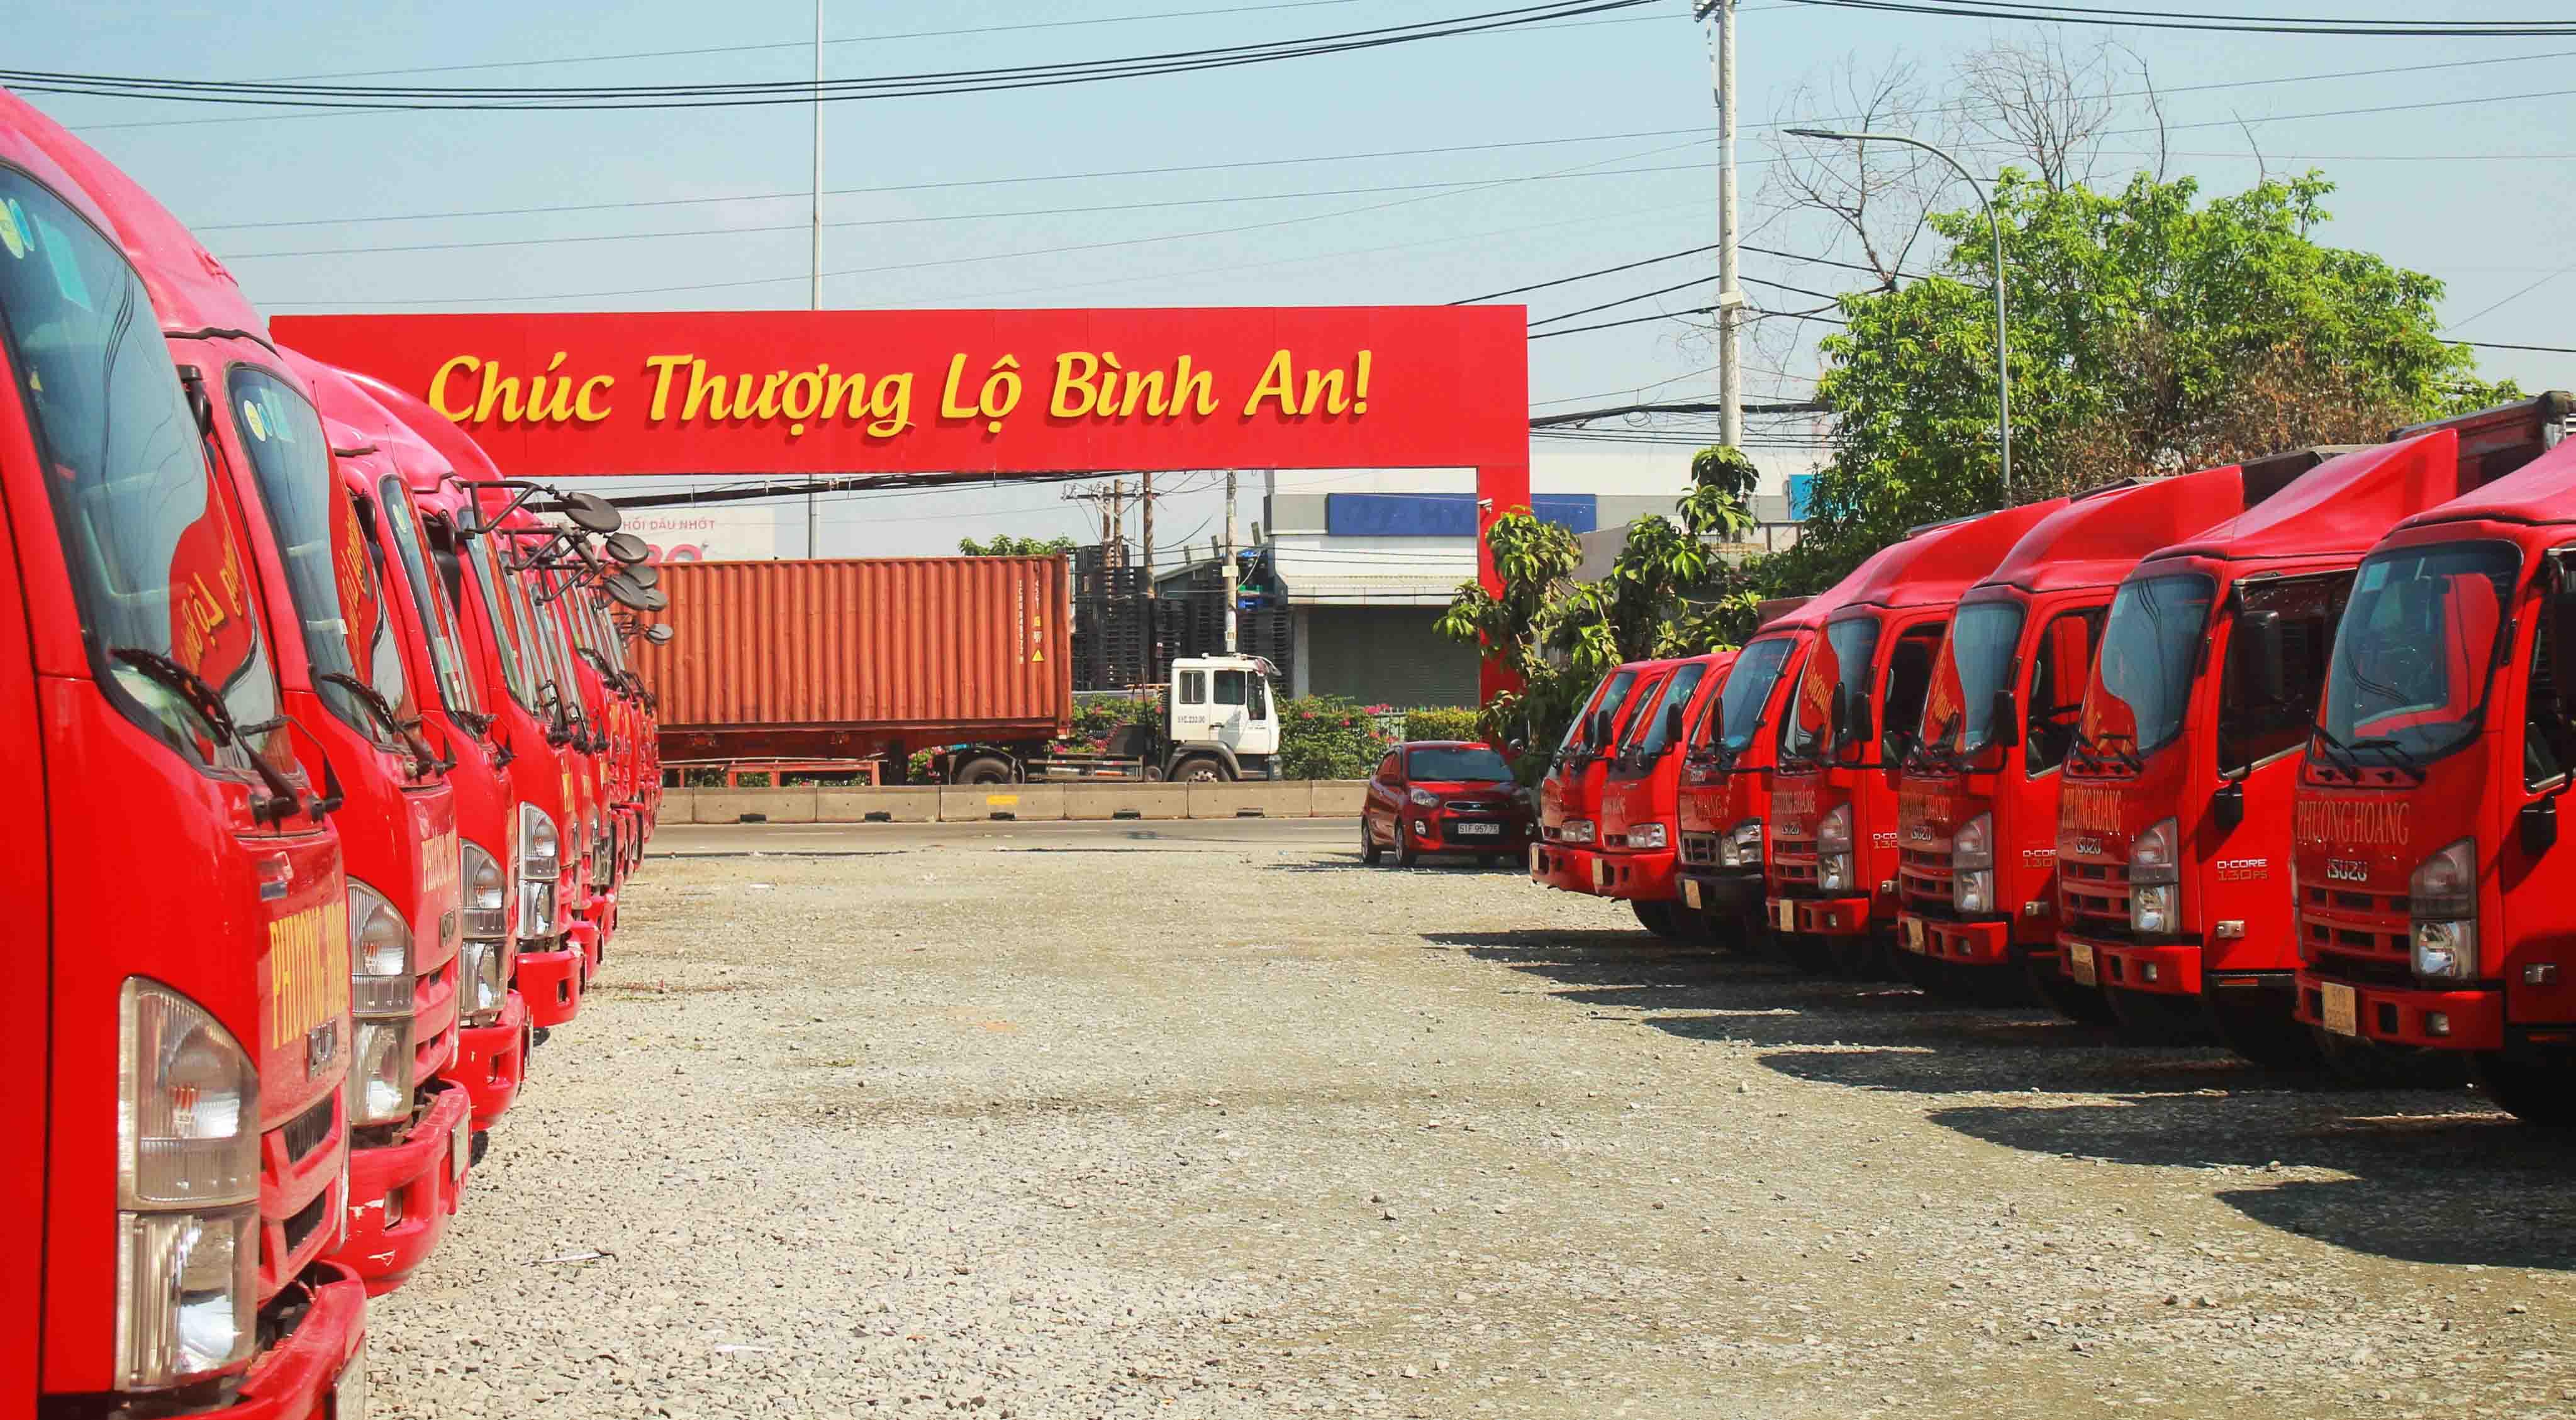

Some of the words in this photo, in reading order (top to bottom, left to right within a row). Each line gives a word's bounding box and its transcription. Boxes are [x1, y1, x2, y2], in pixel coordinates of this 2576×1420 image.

[428, 351, 615, 423] Chúc
[646, 353, 916, 438] Thượng
[941, 352, 1023, 433] Lộ
[1051, 351, 1219, 418] Bình
[1243, 348, 1372, 417] An!
[2326, 858, 2368, 882] ISUZU
